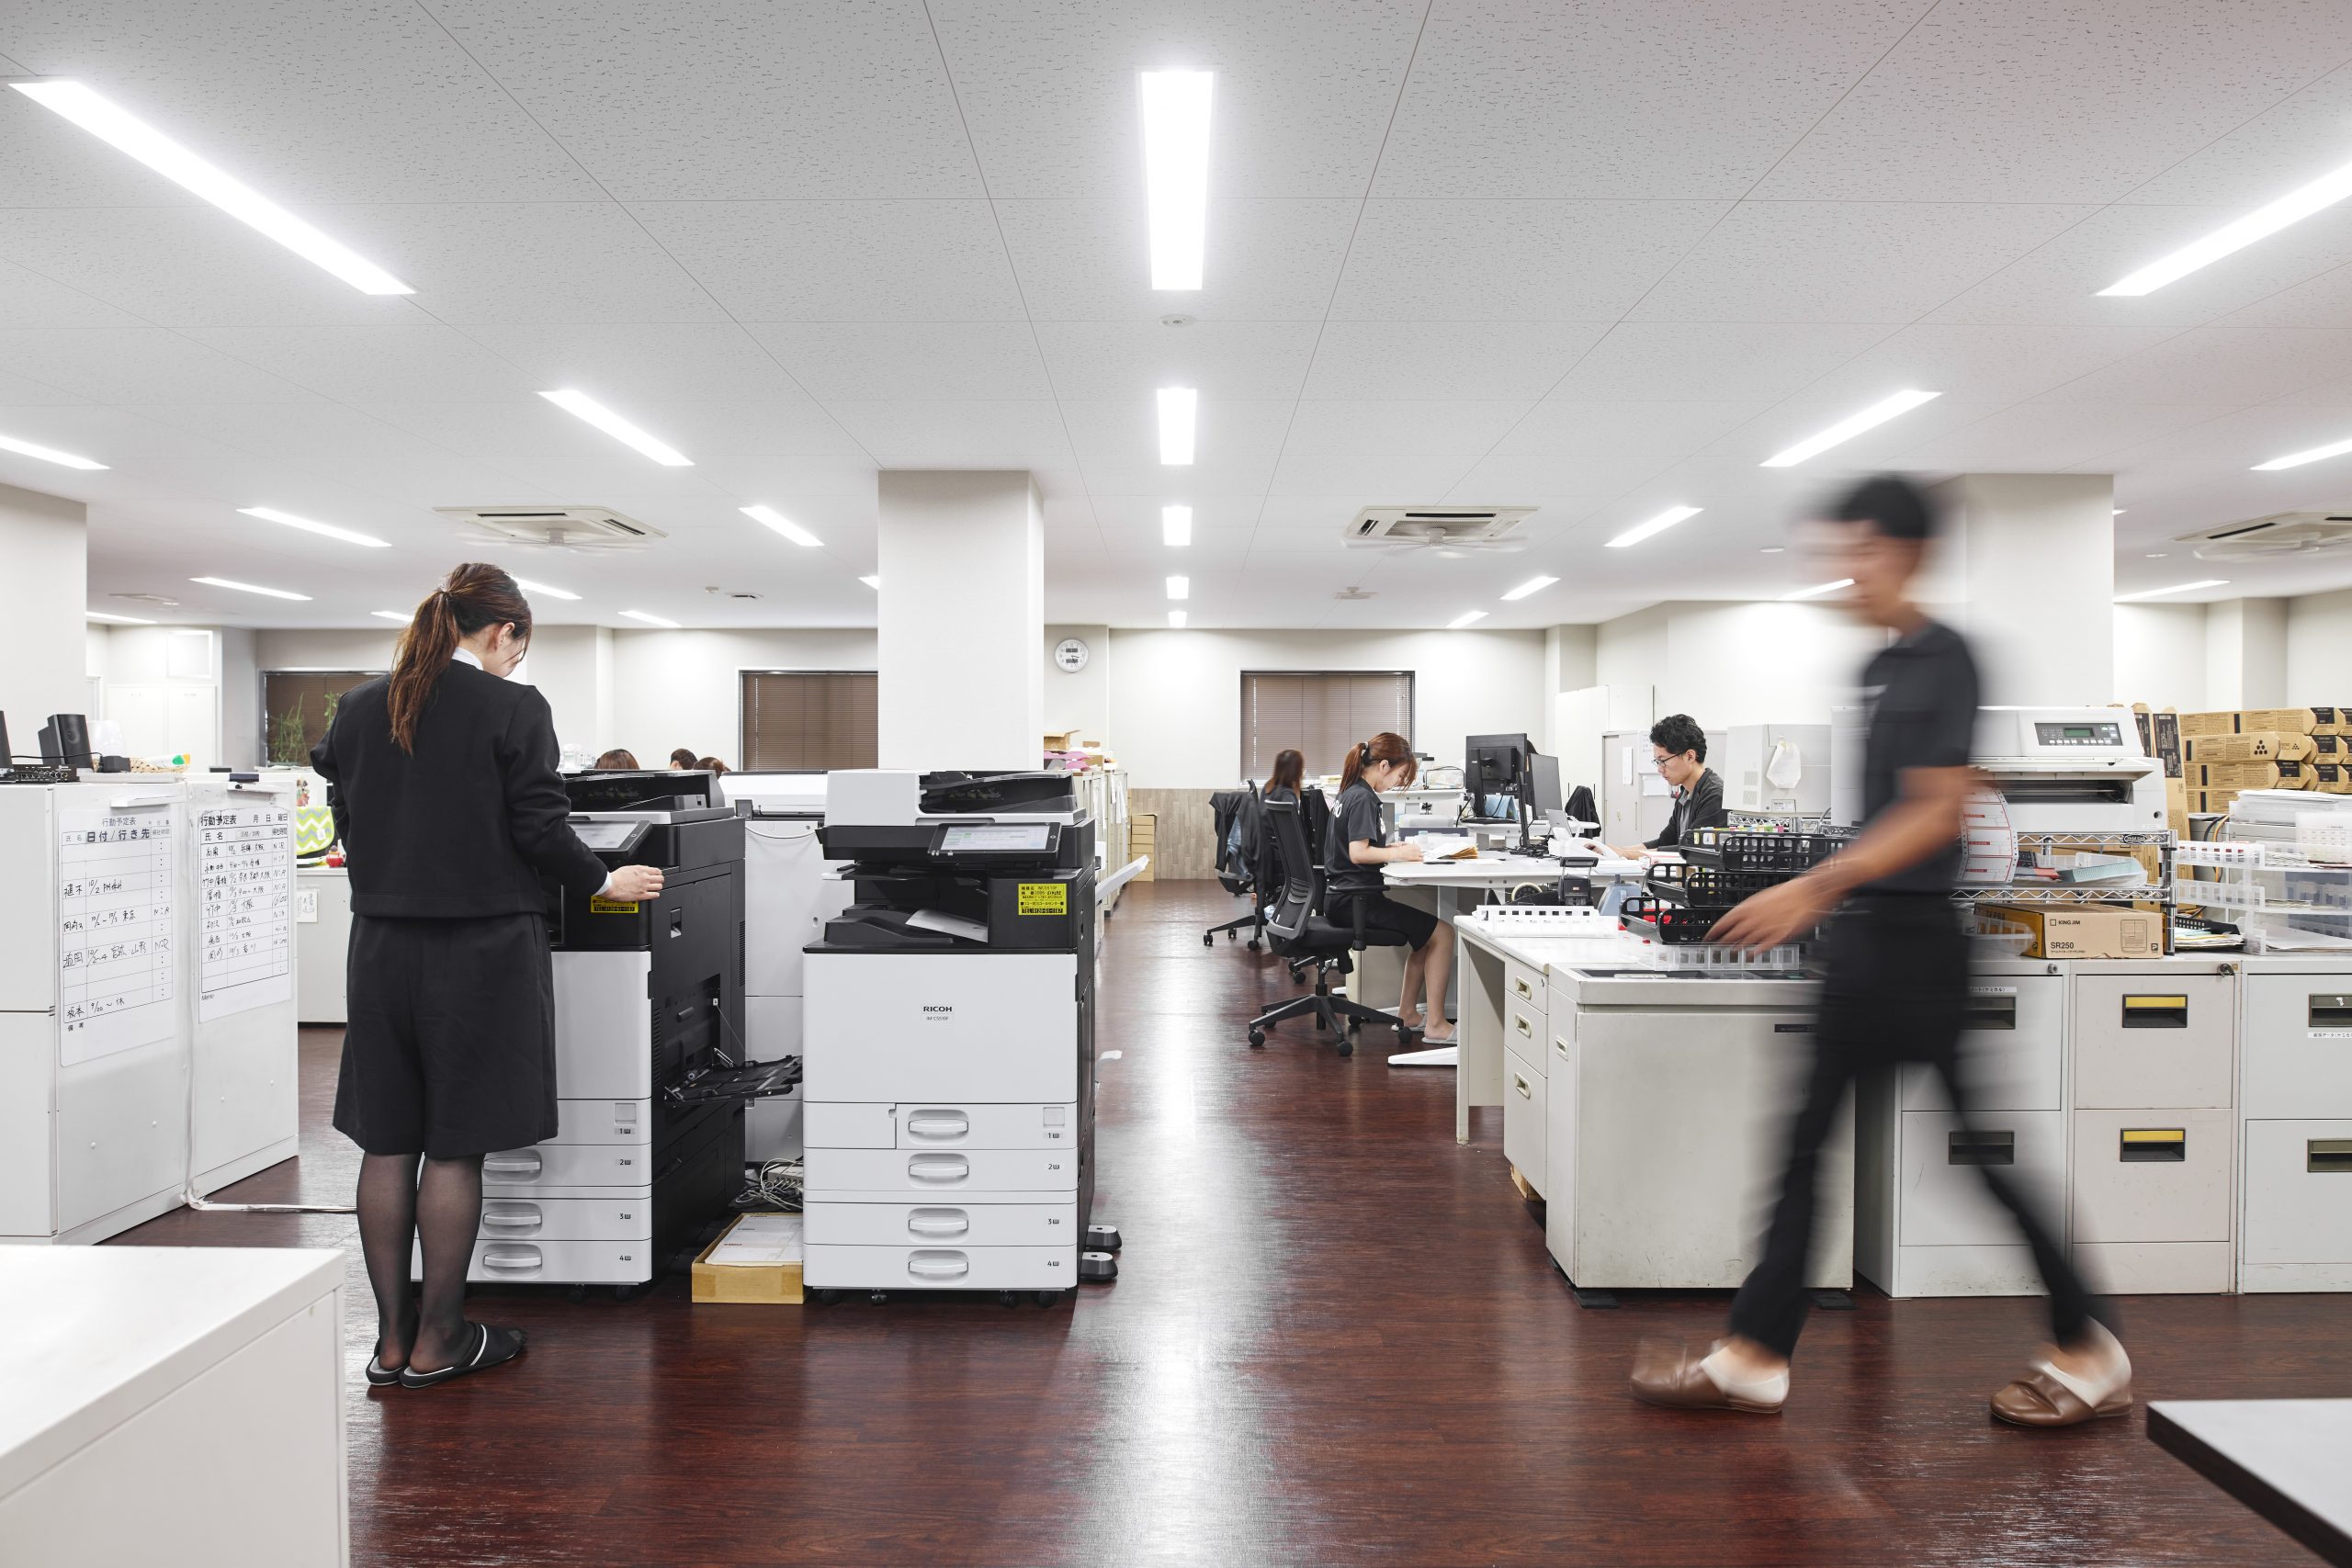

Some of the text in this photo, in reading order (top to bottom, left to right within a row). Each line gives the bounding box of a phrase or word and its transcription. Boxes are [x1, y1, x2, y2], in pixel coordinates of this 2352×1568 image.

[102, 817, 136, 827] 行動予定表
[201, 815, 237, 826] 行動予定表
[205, 831, 223, 840] 氏名
